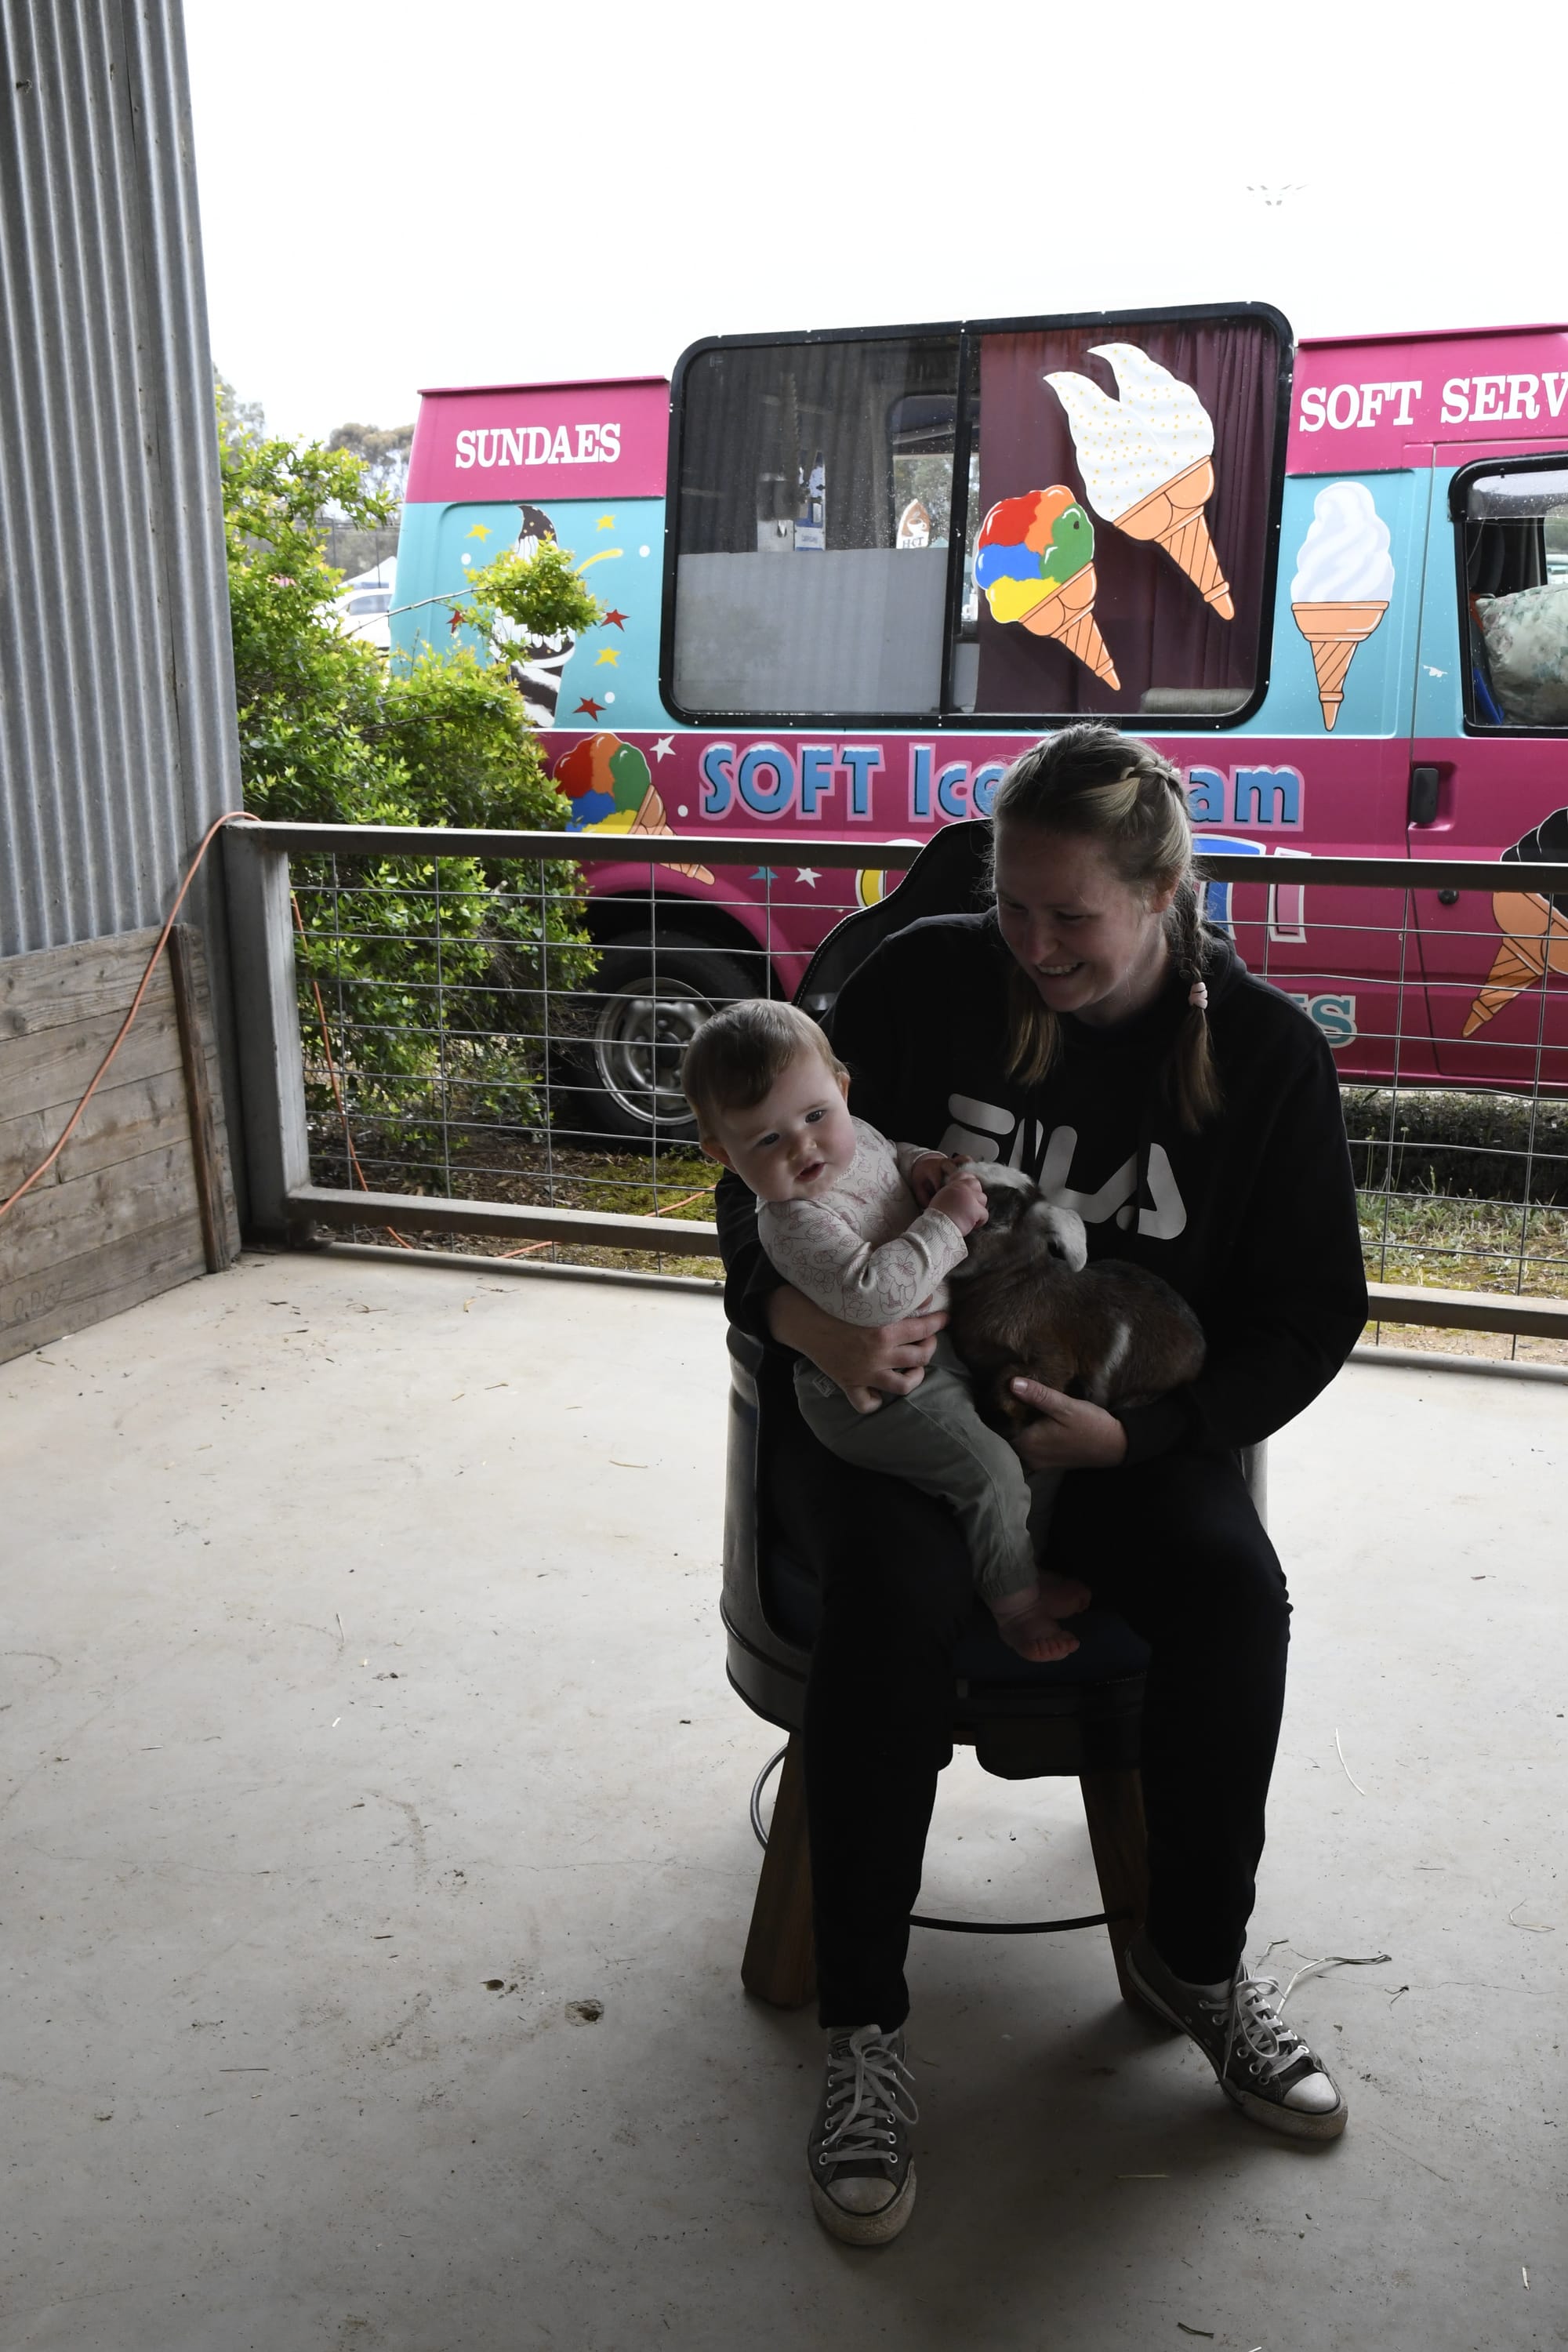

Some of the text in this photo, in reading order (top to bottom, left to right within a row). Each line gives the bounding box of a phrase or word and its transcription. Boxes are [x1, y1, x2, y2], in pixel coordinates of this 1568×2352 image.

[1299, 372, 1568, 432] SOFT SERV
[455, 423, 621, 469] SUNDAES
[699, 741, 886, 822] SOFT
